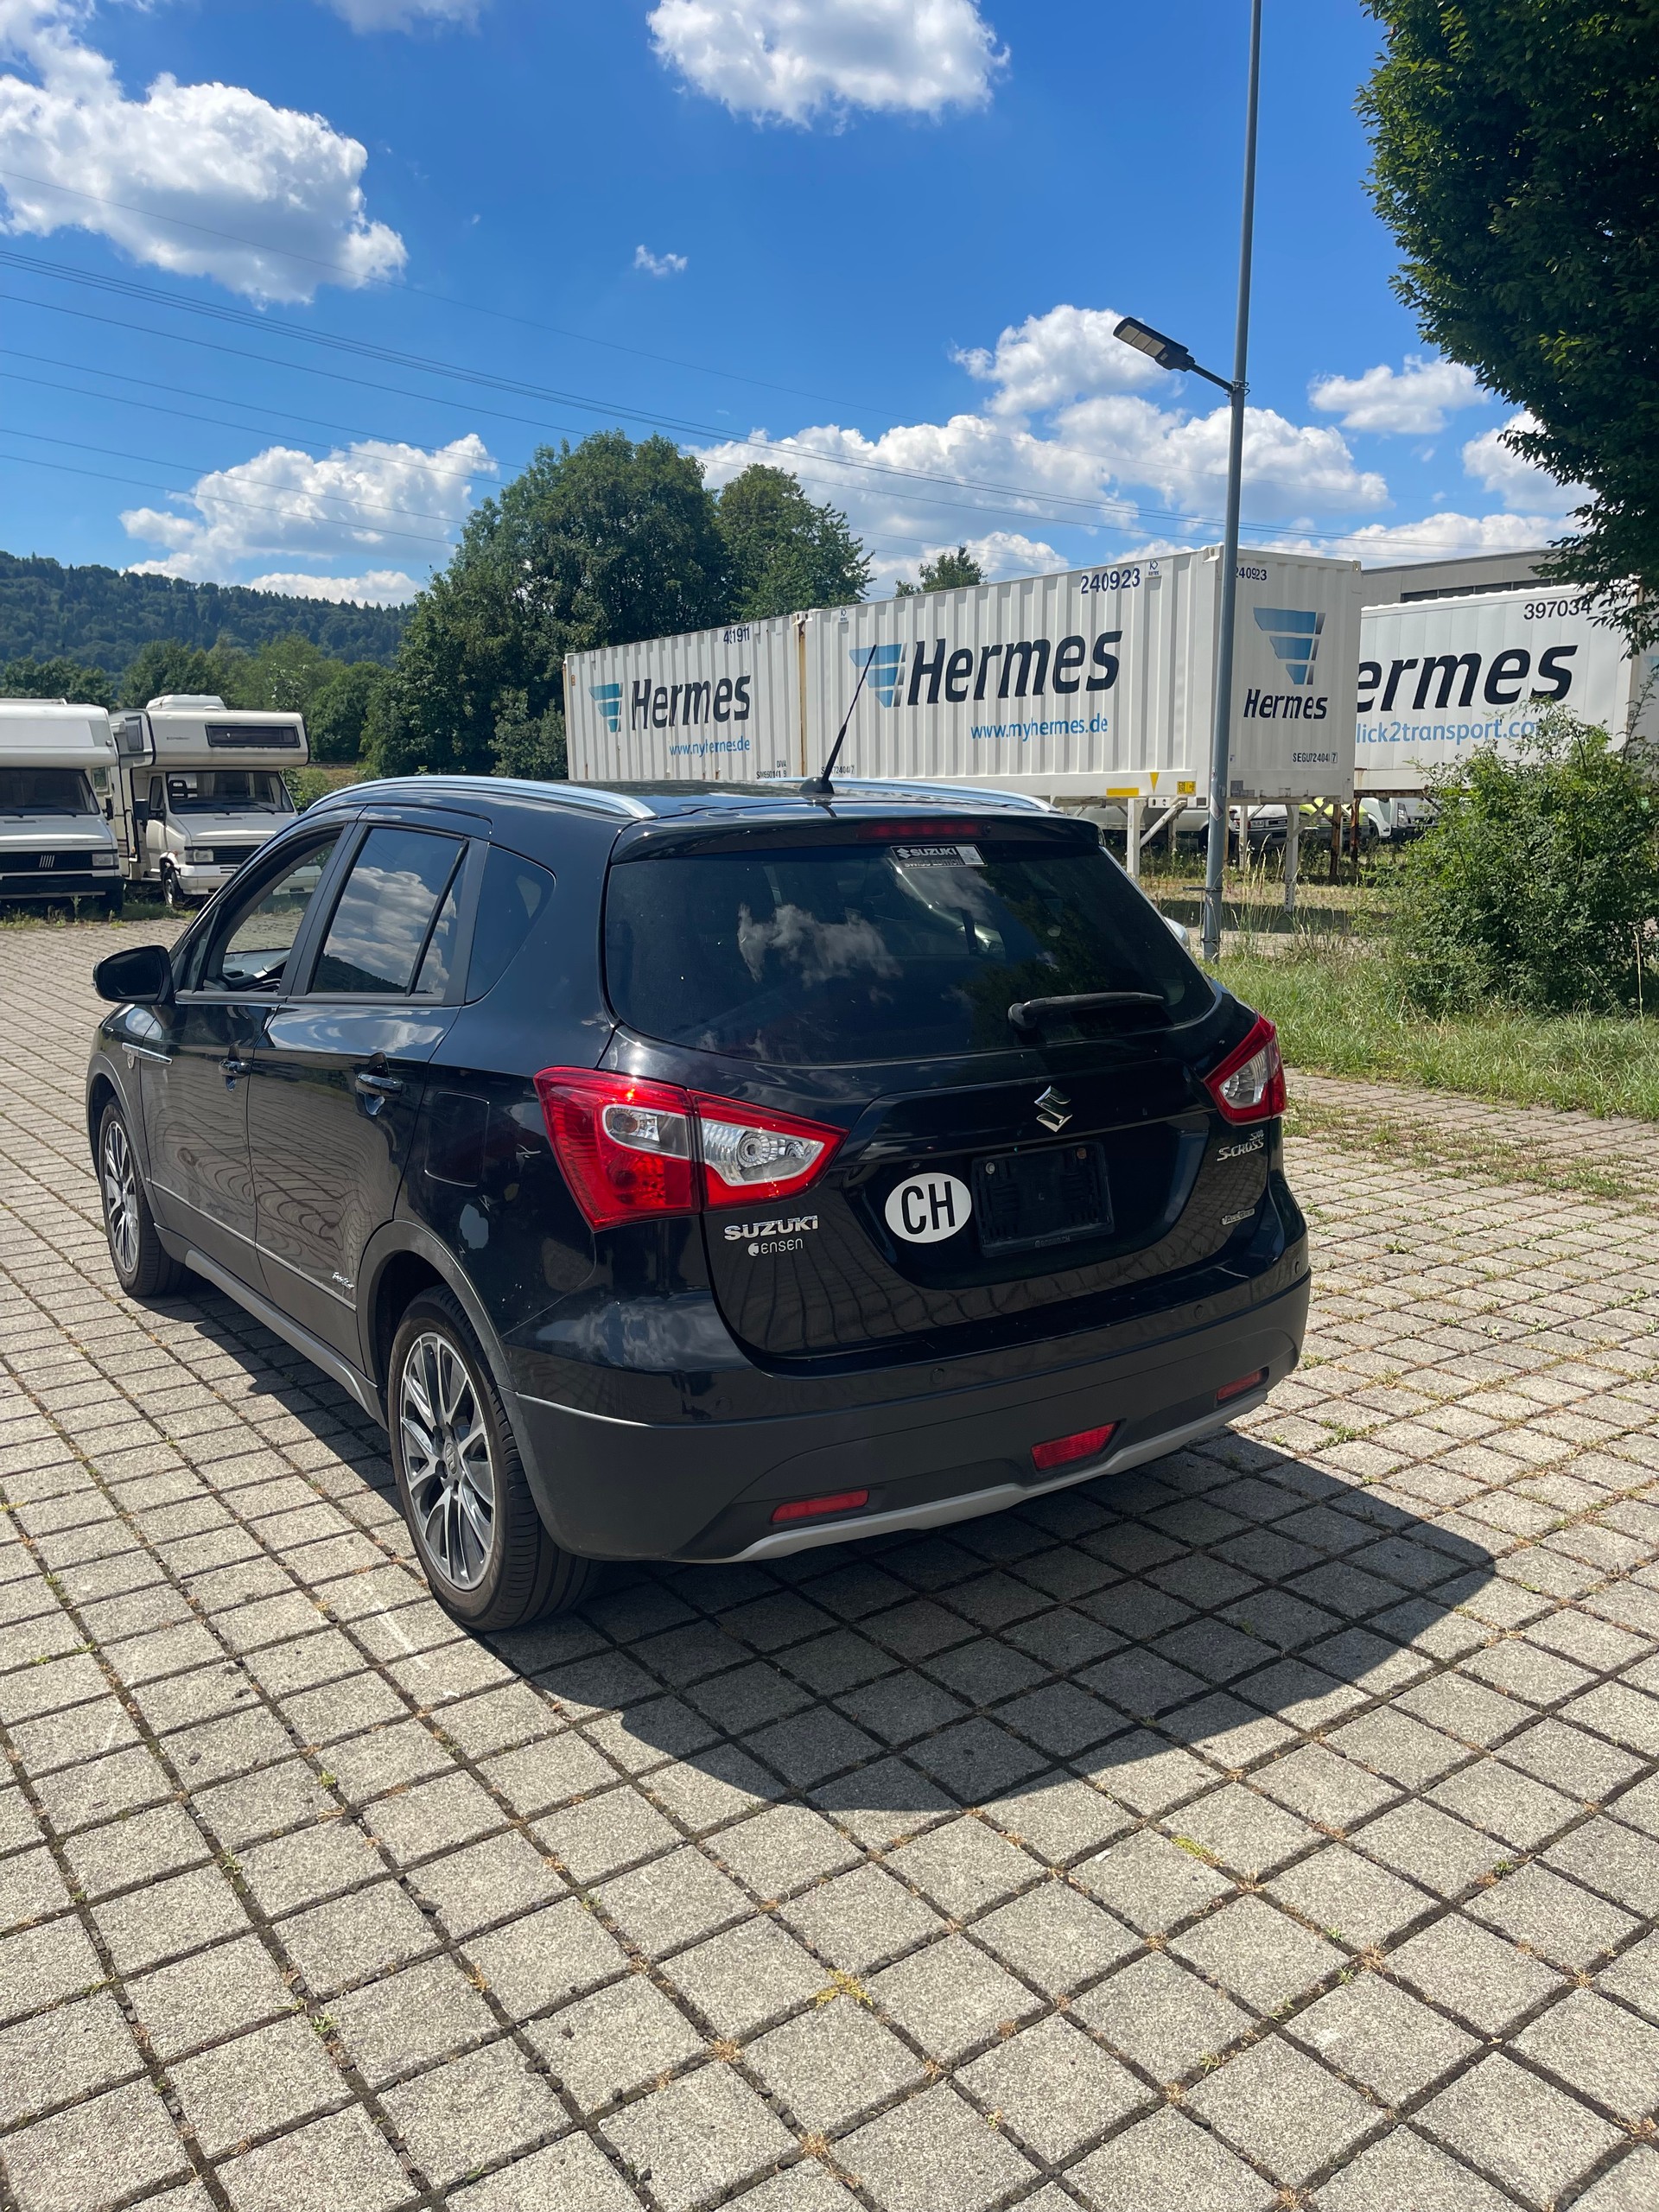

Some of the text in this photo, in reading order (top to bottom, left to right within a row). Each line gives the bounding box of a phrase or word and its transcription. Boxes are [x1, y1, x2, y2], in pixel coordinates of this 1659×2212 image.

[1080, 567, 1141, 594] 240923
[1523, 600, 1592, 620] 397034
[907, 630, 1122, 706] Hermes
[1357, 645, 1579, 714] ermes
[632, 675, 751, 731] Hermes
[1243, 689, 1328, 720] Hermes
[970, 713, 1108, 741] www.myhermes.de
[910, 848, 957, 856] SUZUKI
[901, 1180, 956, 1235] CH
[723, 1215, 819, 1242] SUZUKI
